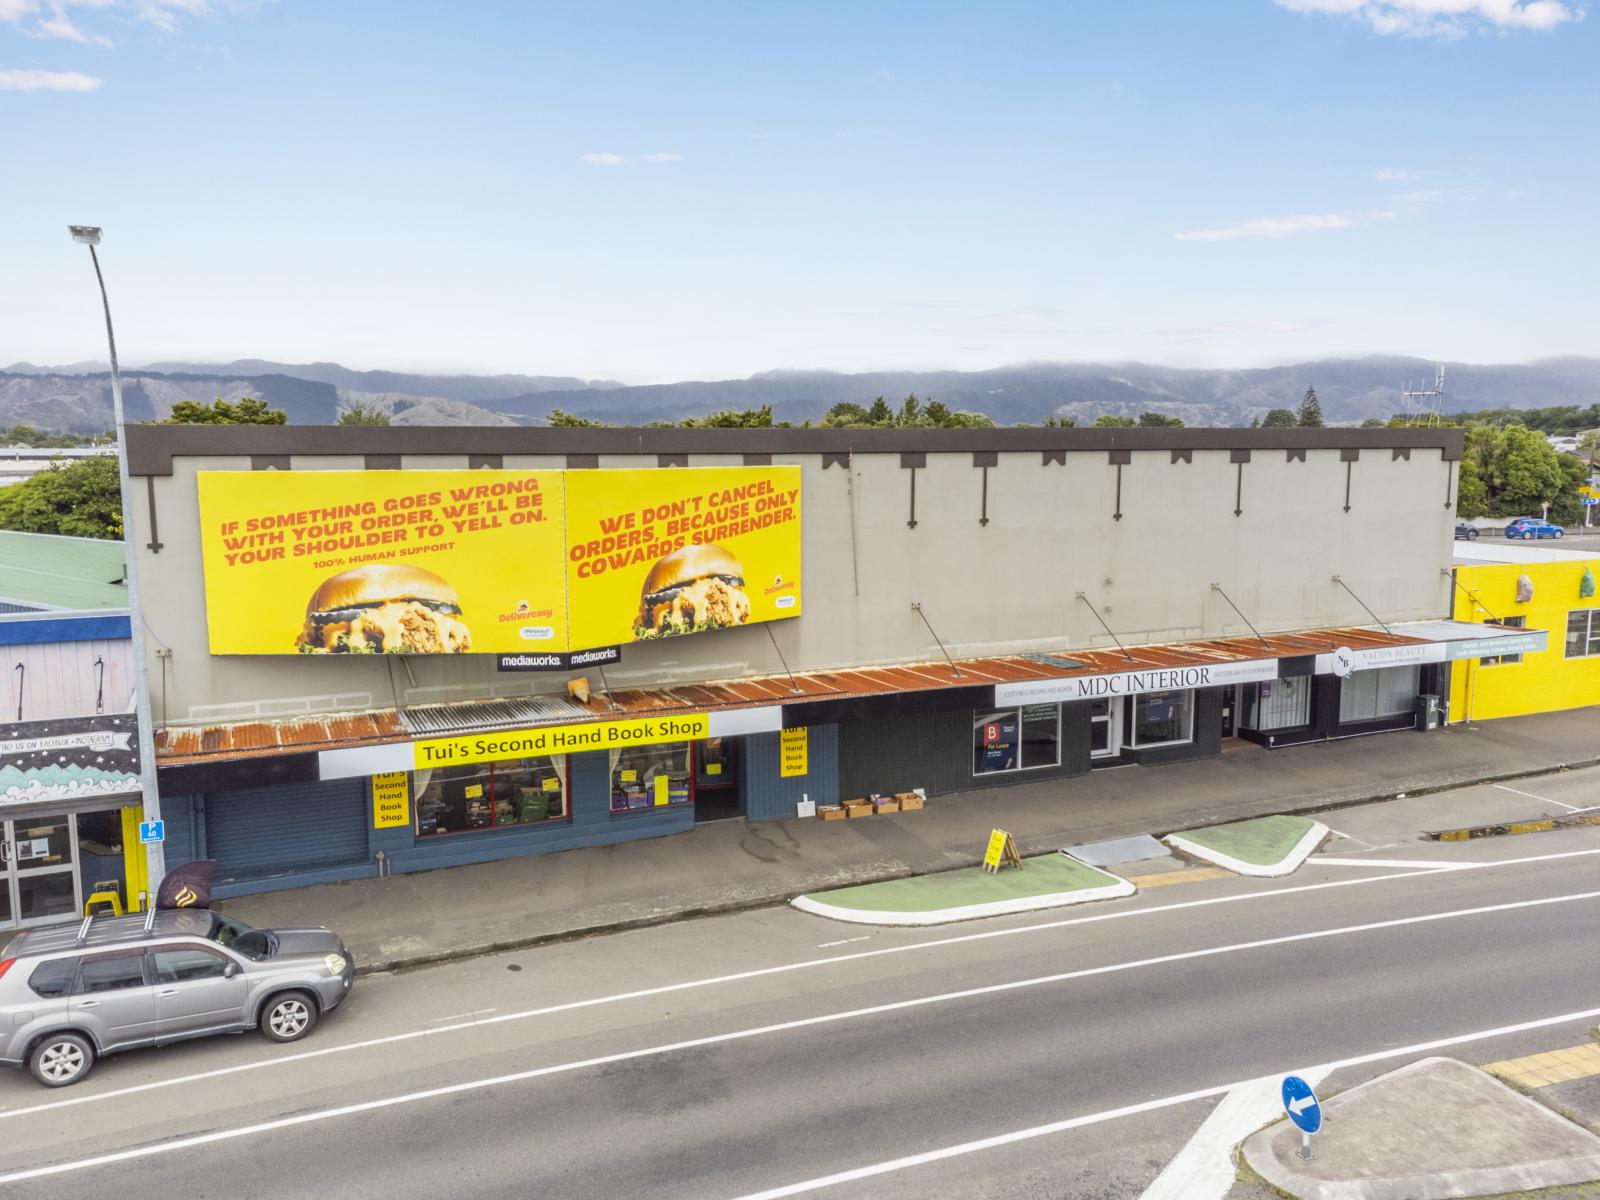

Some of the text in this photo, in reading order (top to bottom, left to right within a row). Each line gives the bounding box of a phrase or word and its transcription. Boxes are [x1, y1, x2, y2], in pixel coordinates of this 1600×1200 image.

[221, 478, 539, 536] IF SOMETHING GOES WRONG
[223, 493, 543, 551] WITH YOUR ORDER, WE'LL BE
[599, 479, 774, 535] WE DON'T CANCEL
[224, 509, 548, 567] YOUR SHOULDER TO YELL ON.
[569, 488, 799, 561] ORDERS, BECAUSE ONLY
[313, 541, 455, 569] 100% HUMAN SUPPORT
[577, 507, 796, 579] COWARDS SURRENDER.
[1078, 667, 1211, 697] MDC INTERIOR
[422, 717, 704, 762] Tui's Second Hand Book Shop
[782, 735, 806, 743] Second
[988, 726, 997, 740] B
[375, 780, 406, 790] Second
[379, 791, 403, 801] Hand
[380, 802, 403, 811] Book
[380, 814, 403, 822] Shop
